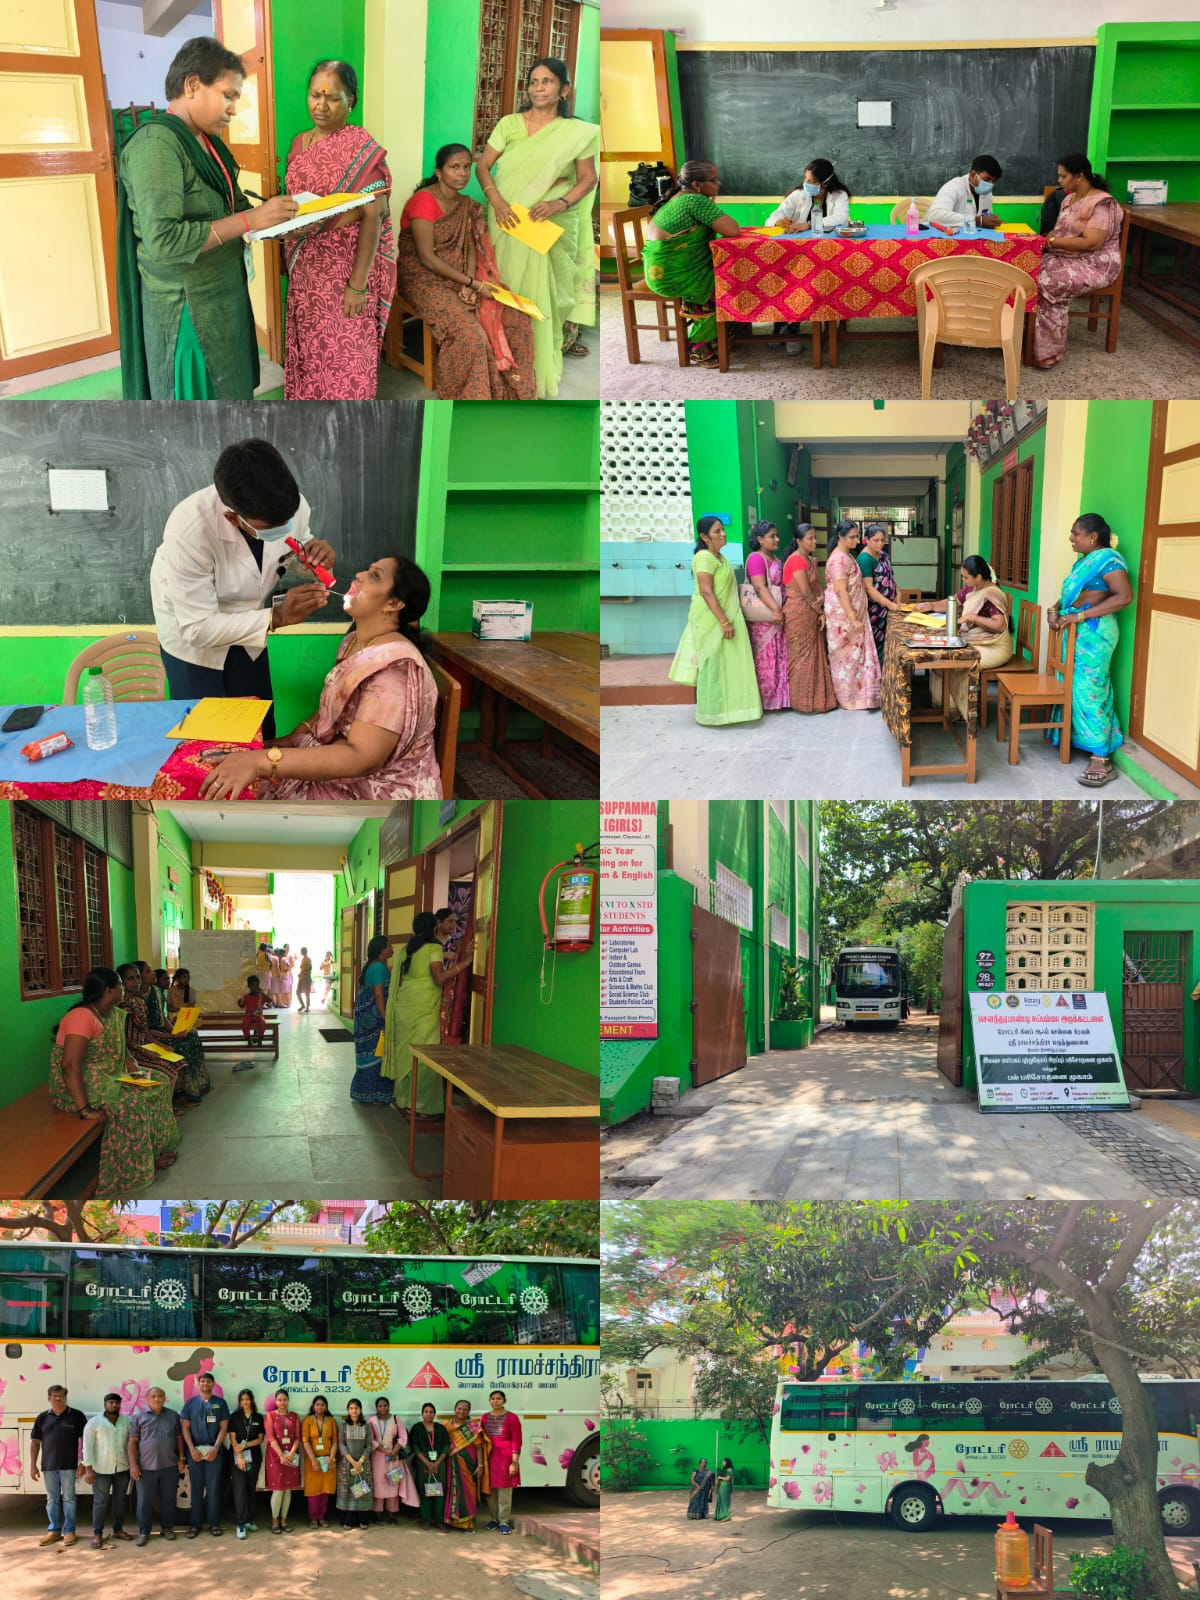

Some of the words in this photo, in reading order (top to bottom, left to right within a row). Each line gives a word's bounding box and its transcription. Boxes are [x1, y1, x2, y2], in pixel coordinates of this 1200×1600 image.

[600, 801, 656, 815] SUPPAMMA
[604, 818, 642, 832] (GIRLS)
[622, 871, 653, 880] English
[979, 952, 991, 960] 97
[979, 972, 990, 981] 98
[218, 1287, 279, 1303] ரோட்டரி
[342, 1291, 400, 1306] ரோட்டரி
[460, 1293, 517, 1307] ரோட்டரி
[262, 1364, 352, 1386] ரோட்டரி
[325, 1385, 352, 1393] 3232
[955, 1443, 1007, 1456] ரோட்டரி
